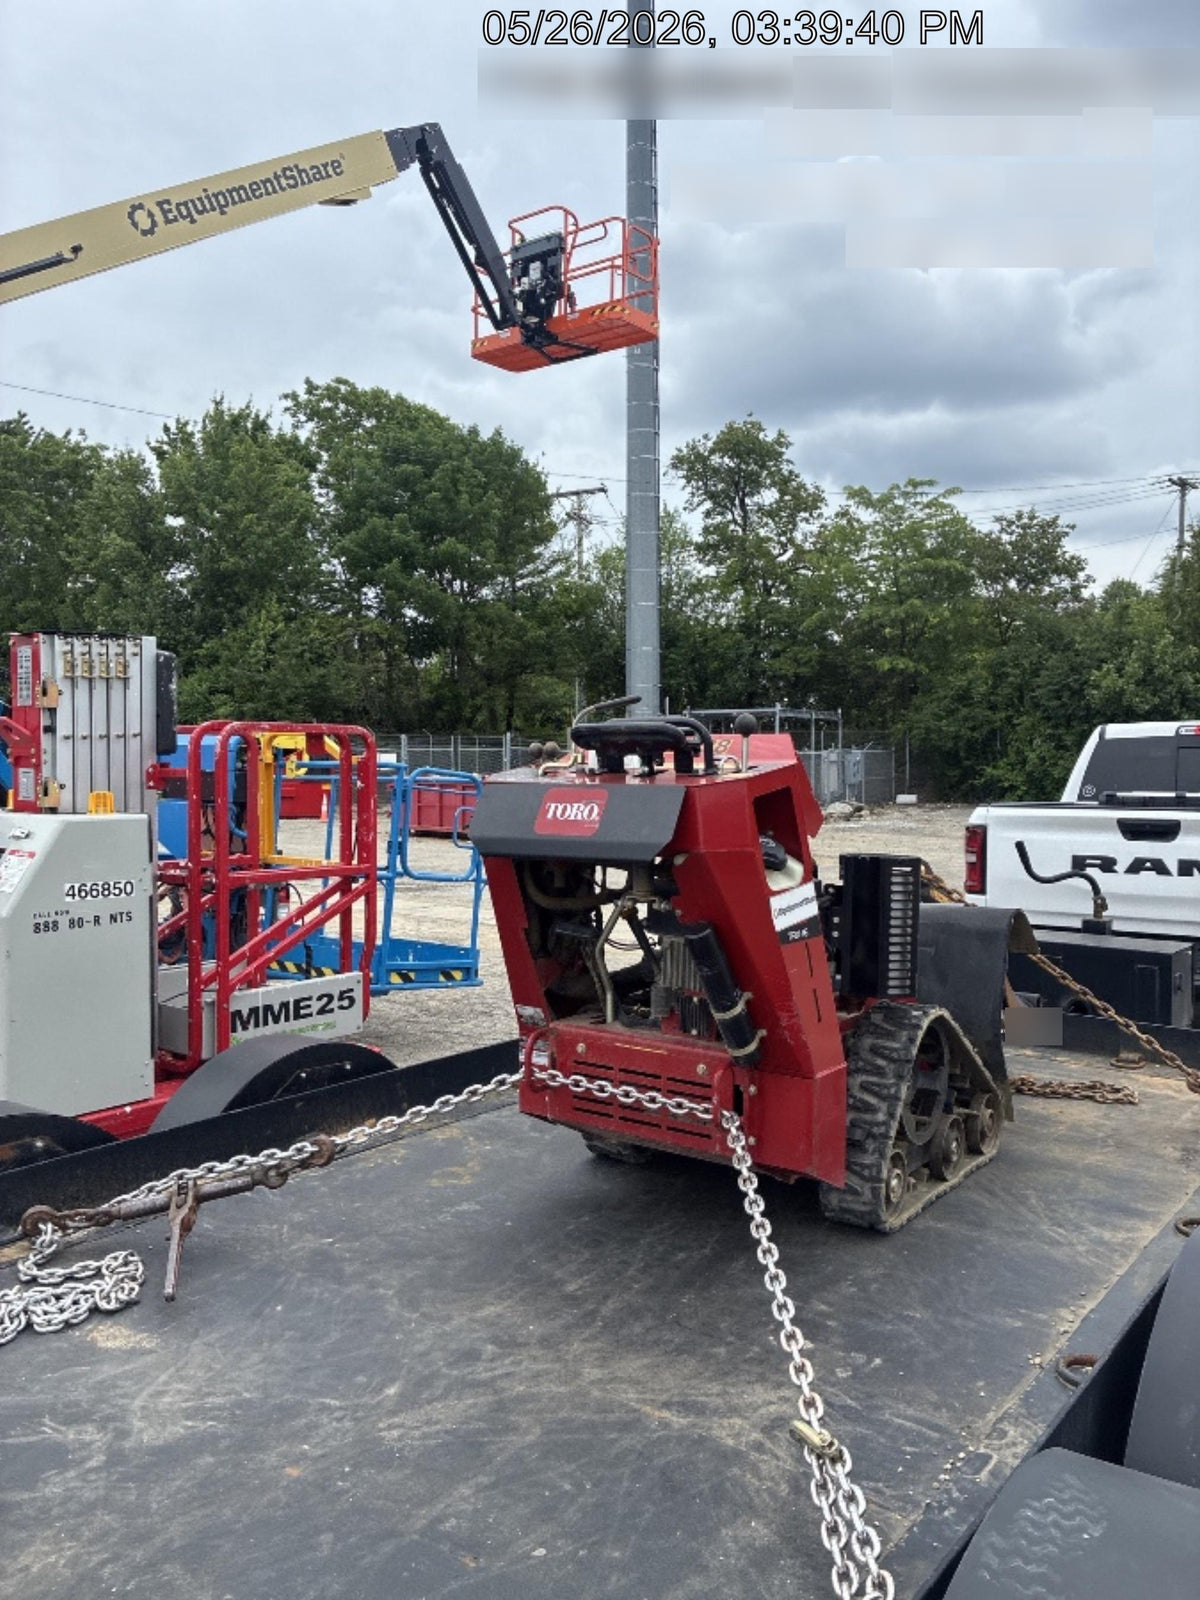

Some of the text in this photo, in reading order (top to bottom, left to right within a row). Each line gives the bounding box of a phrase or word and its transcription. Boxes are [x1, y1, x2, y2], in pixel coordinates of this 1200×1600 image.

[156, 157, 344, 226] EquipmentShare
[545, 802, 600, 821] TORO
[65, 881, 134, 900] 466850
[230, 988, 356, 1034] MME25
